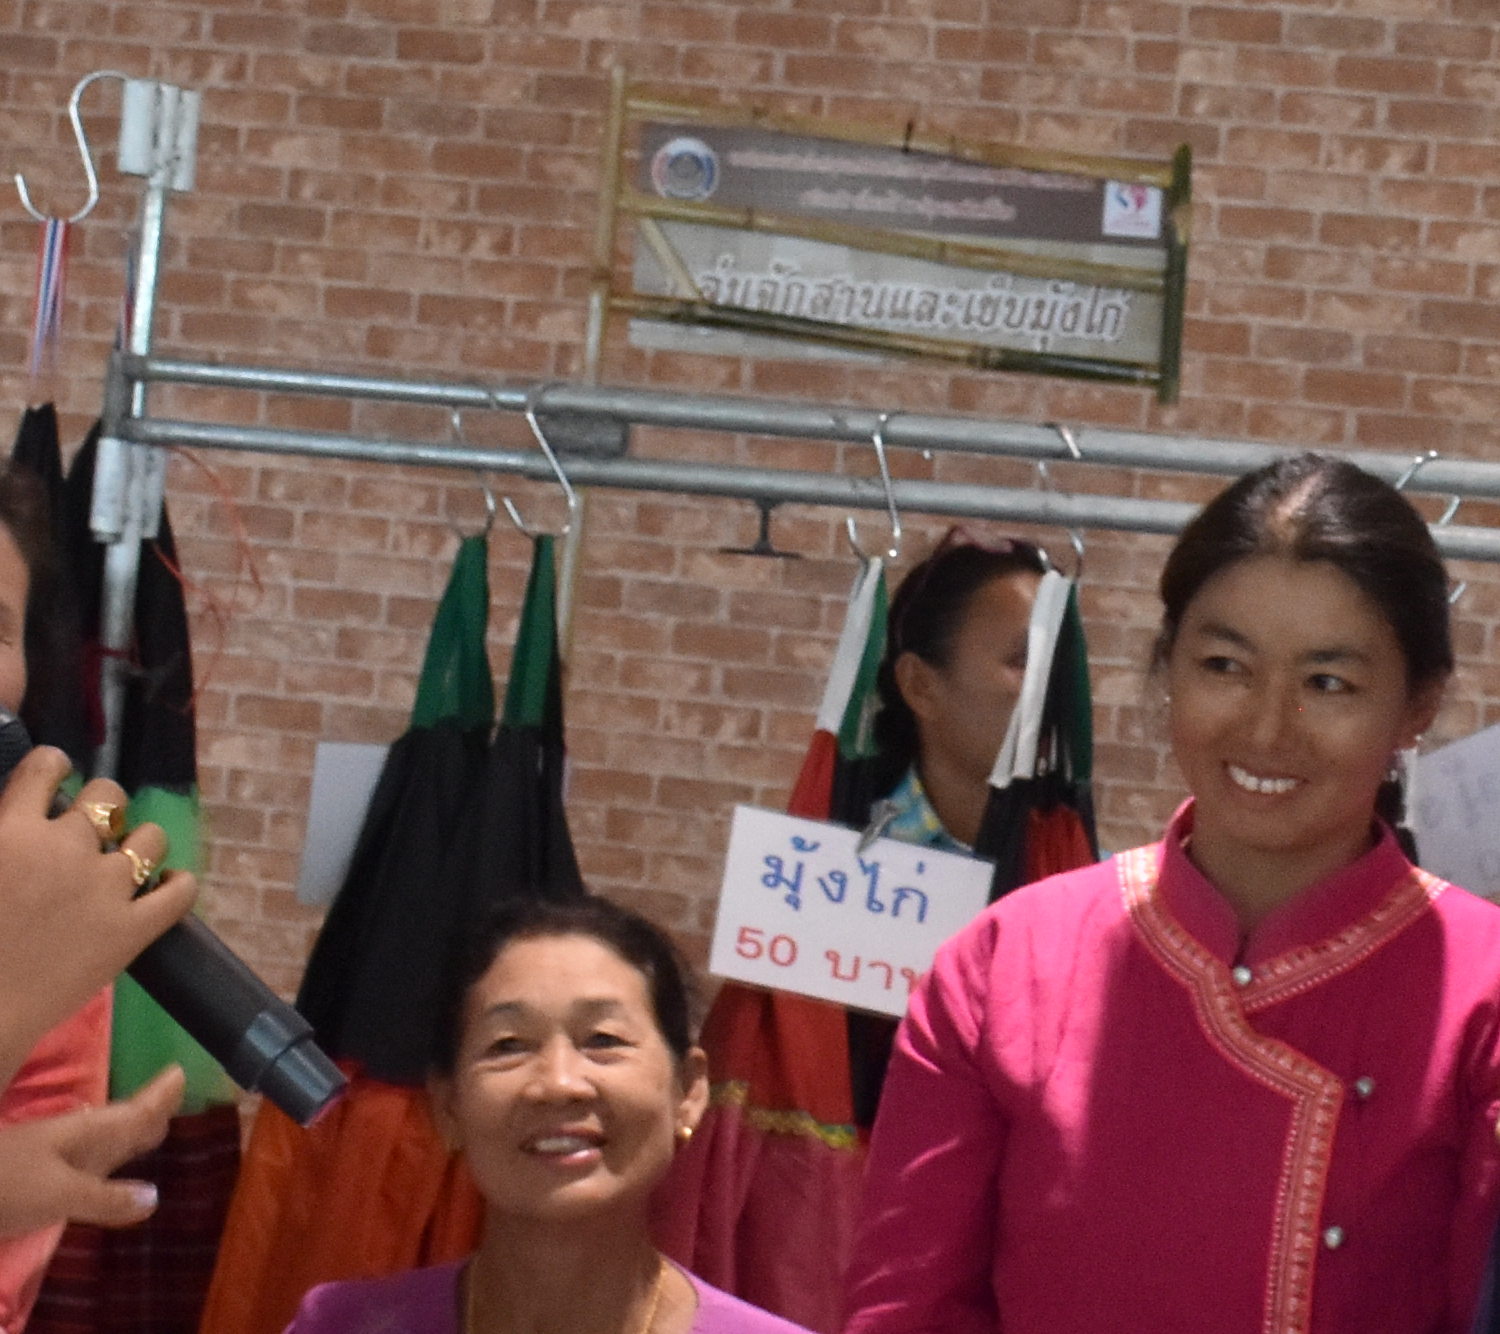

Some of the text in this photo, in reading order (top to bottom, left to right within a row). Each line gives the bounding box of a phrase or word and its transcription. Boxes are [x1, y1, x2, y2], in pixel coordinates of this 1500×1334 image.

[761, 835, 929, 924] มุ้งไก่
[735, 925, 798, 967] 50
